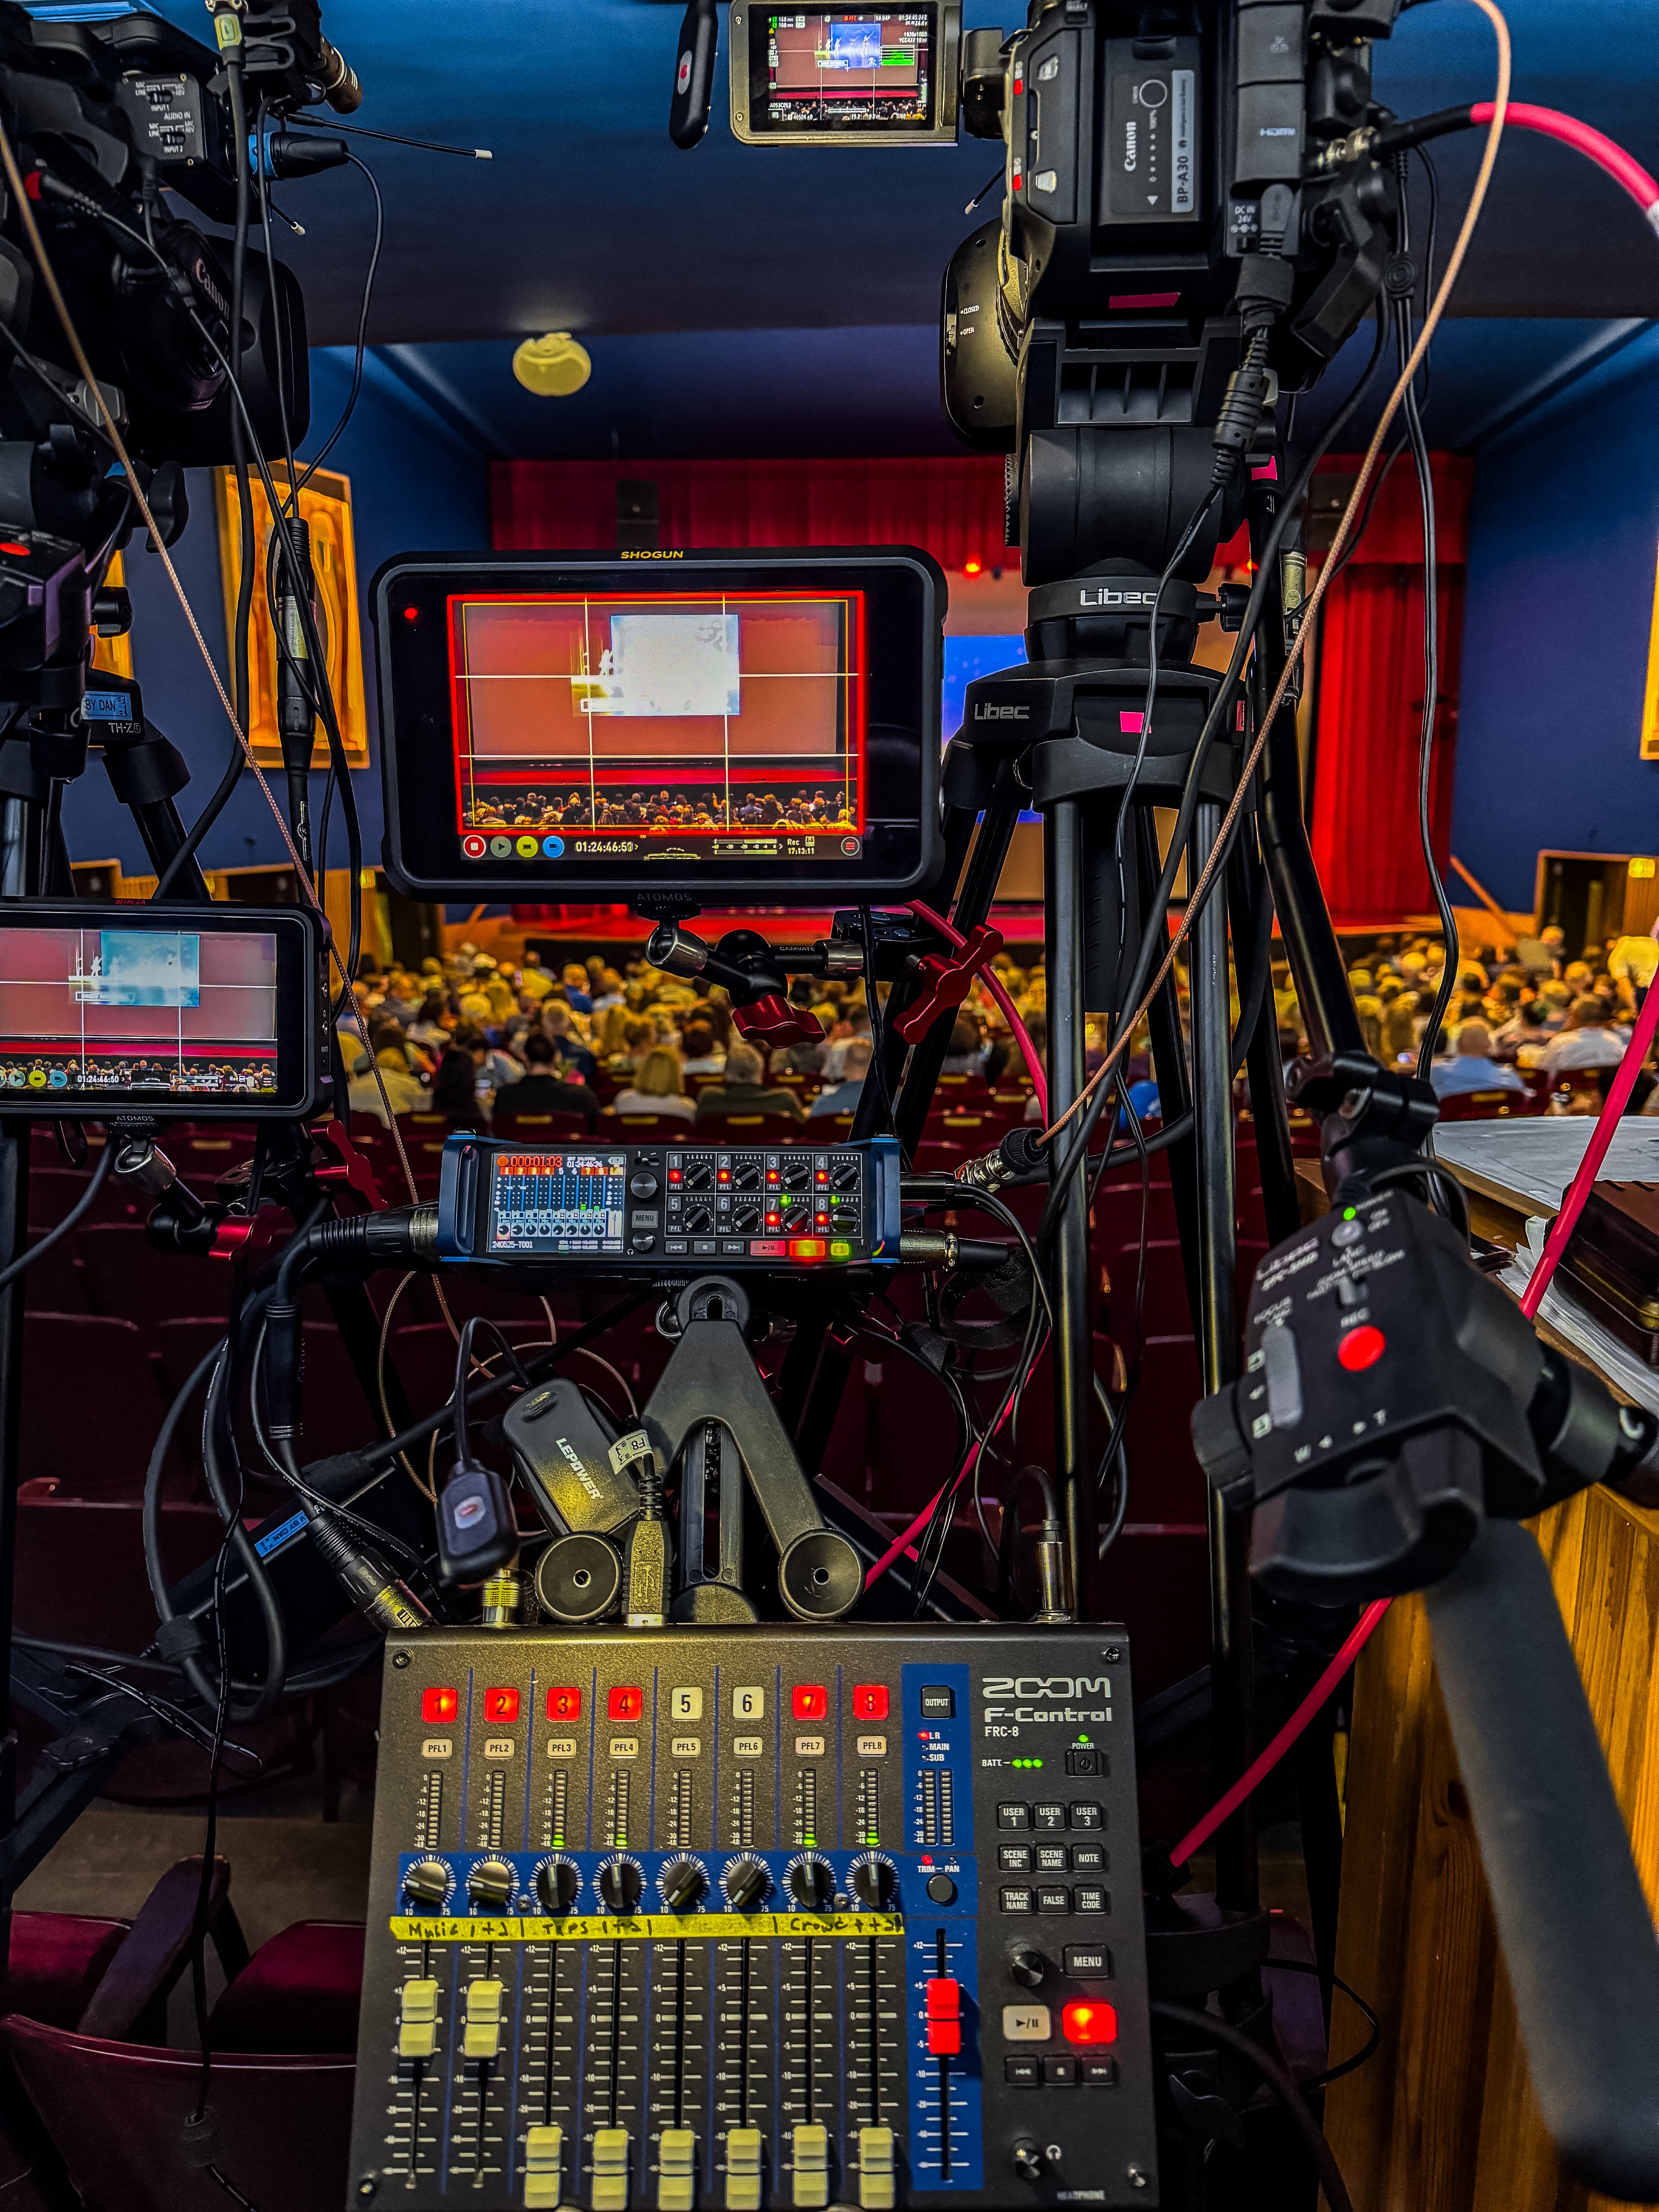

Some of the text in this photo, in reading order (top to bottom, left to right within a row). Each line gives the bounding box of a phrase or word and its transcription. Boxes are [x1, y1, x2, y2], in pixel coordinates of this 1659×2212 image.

[164, 111, 183, 121] AUDIO
[1125, 121, 1136, 172] Canon
[1177, 155, 1189, 203] BP-A30
[963, 305, 979, 315] CLOSED
[963, 327, 974, 335] OPEN
[1080, 589, 1158, 606] Libec
[86, 699, 116, 711] BY DAN
[974, 703, 1030, 720] Libec
[637, 893, 692, 901] ATOMOS
[510, 1155, 563, 1167] 000:01:03
[673, 1156, 678, 1167] 1
[721, 1156, 728, 1167] 2
[770, 1157, 776, 1168] 3
[818, 1157, 825, 1168] 4
[671, 1198, 678, 1210] 5
[721, 1198, 727, 1210] 6
[769, 1199, 776, 1210] 7
[819, 1199, 825, 1210] 8
[632, 1437, 645, 1450] F8
[982, 1677, 1111, 1698] ZOOM
[435, 1696, 442, 1714] 1
[496, 1696, 506, 1715] 2
[558, 1695, 568, 1714] 3
[619, 1695, 629, 1713] 4
[681, 1694, 690, 1713] 5
[742, 1694, 752, 1713] 6
[985, 1707, 1112, 1723] F-Control
[985, 1726, 1019, 1737] FRC-8
[428, 1744, 446, 1753] PFL1
[490, 1744, 509, 1752] PFL2
[552, 1744, 571, 1752] PFL3
[615, 1743, 633, 1752] PFL4
[677, 1742, 696, 1751] PFL5
[739, 1742, 758, 1751] PFL6
[801, 1742, 820, 1750] PFL7
[863, 1741, 882, 1750] PFL8
[1076, 1807, 1097, 1815] USER
[1012, 1818, 1017, 1826] 1
[1048, 1817, 1055, 1826] 2
[1084, 1817, 1091, 1826] 3
[1003, 1850, 1027, 1859] SCENE
[1040, 1850, 1063, 1859] SCENE
[1079, 1854, 1099, 1862] NOTE
[1009, 1859, 1022, 1868] INC
[1005, 1892, 1028, 1901] TRACK
[1043, 1896, 1065, 1905] FALSE
[698, 1905, 706, 1913] 75
[851, 1904, 859, 1913] 10
[1007, 1901, 1028, 1910] NAME
[1082, 1901, 1100, 1909] CODE
[442, 1907, 451, 1915] 75
[506, 1907, 514, 1915] 75
[533, 1907, 541, 1915] 10
[570, 1906, 578, 1914] 75
[597, 1906, 604, 1914] 10
[634, 1906, 642, 1914] 75
[1073, 1956, 1102, 1967] MENU
